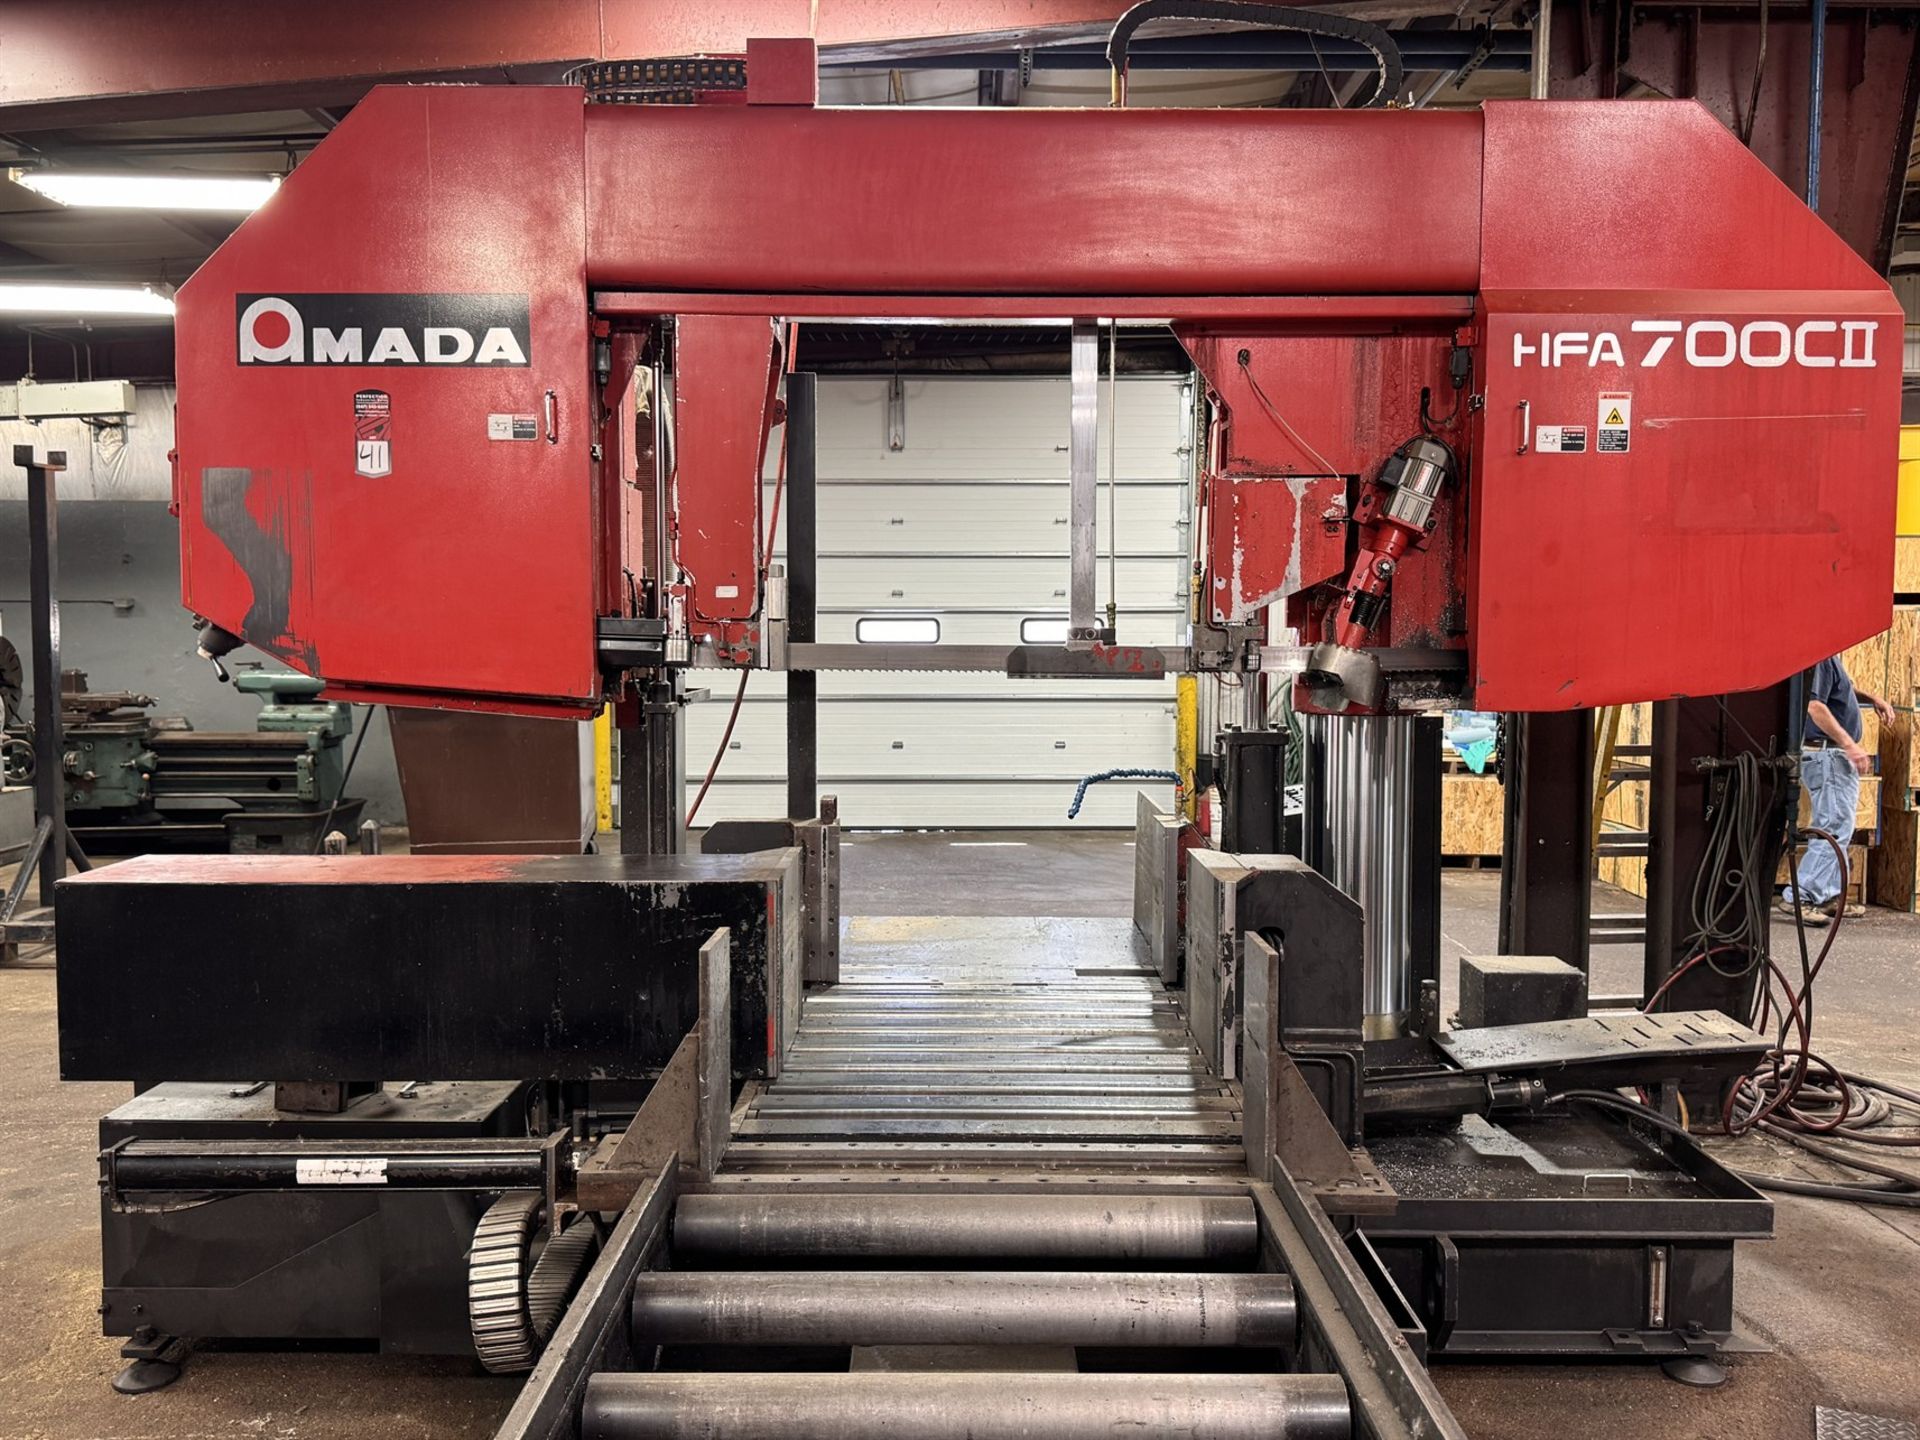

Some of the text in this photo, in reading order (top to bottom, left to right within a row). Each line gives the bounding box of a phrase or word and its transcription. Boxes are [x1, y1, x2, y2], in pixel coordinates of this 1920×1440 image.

[239, 297, 527, 363] AMADA
[1514, 331, 1625, 368] HFA
[359, 444, 382, 469] 41
